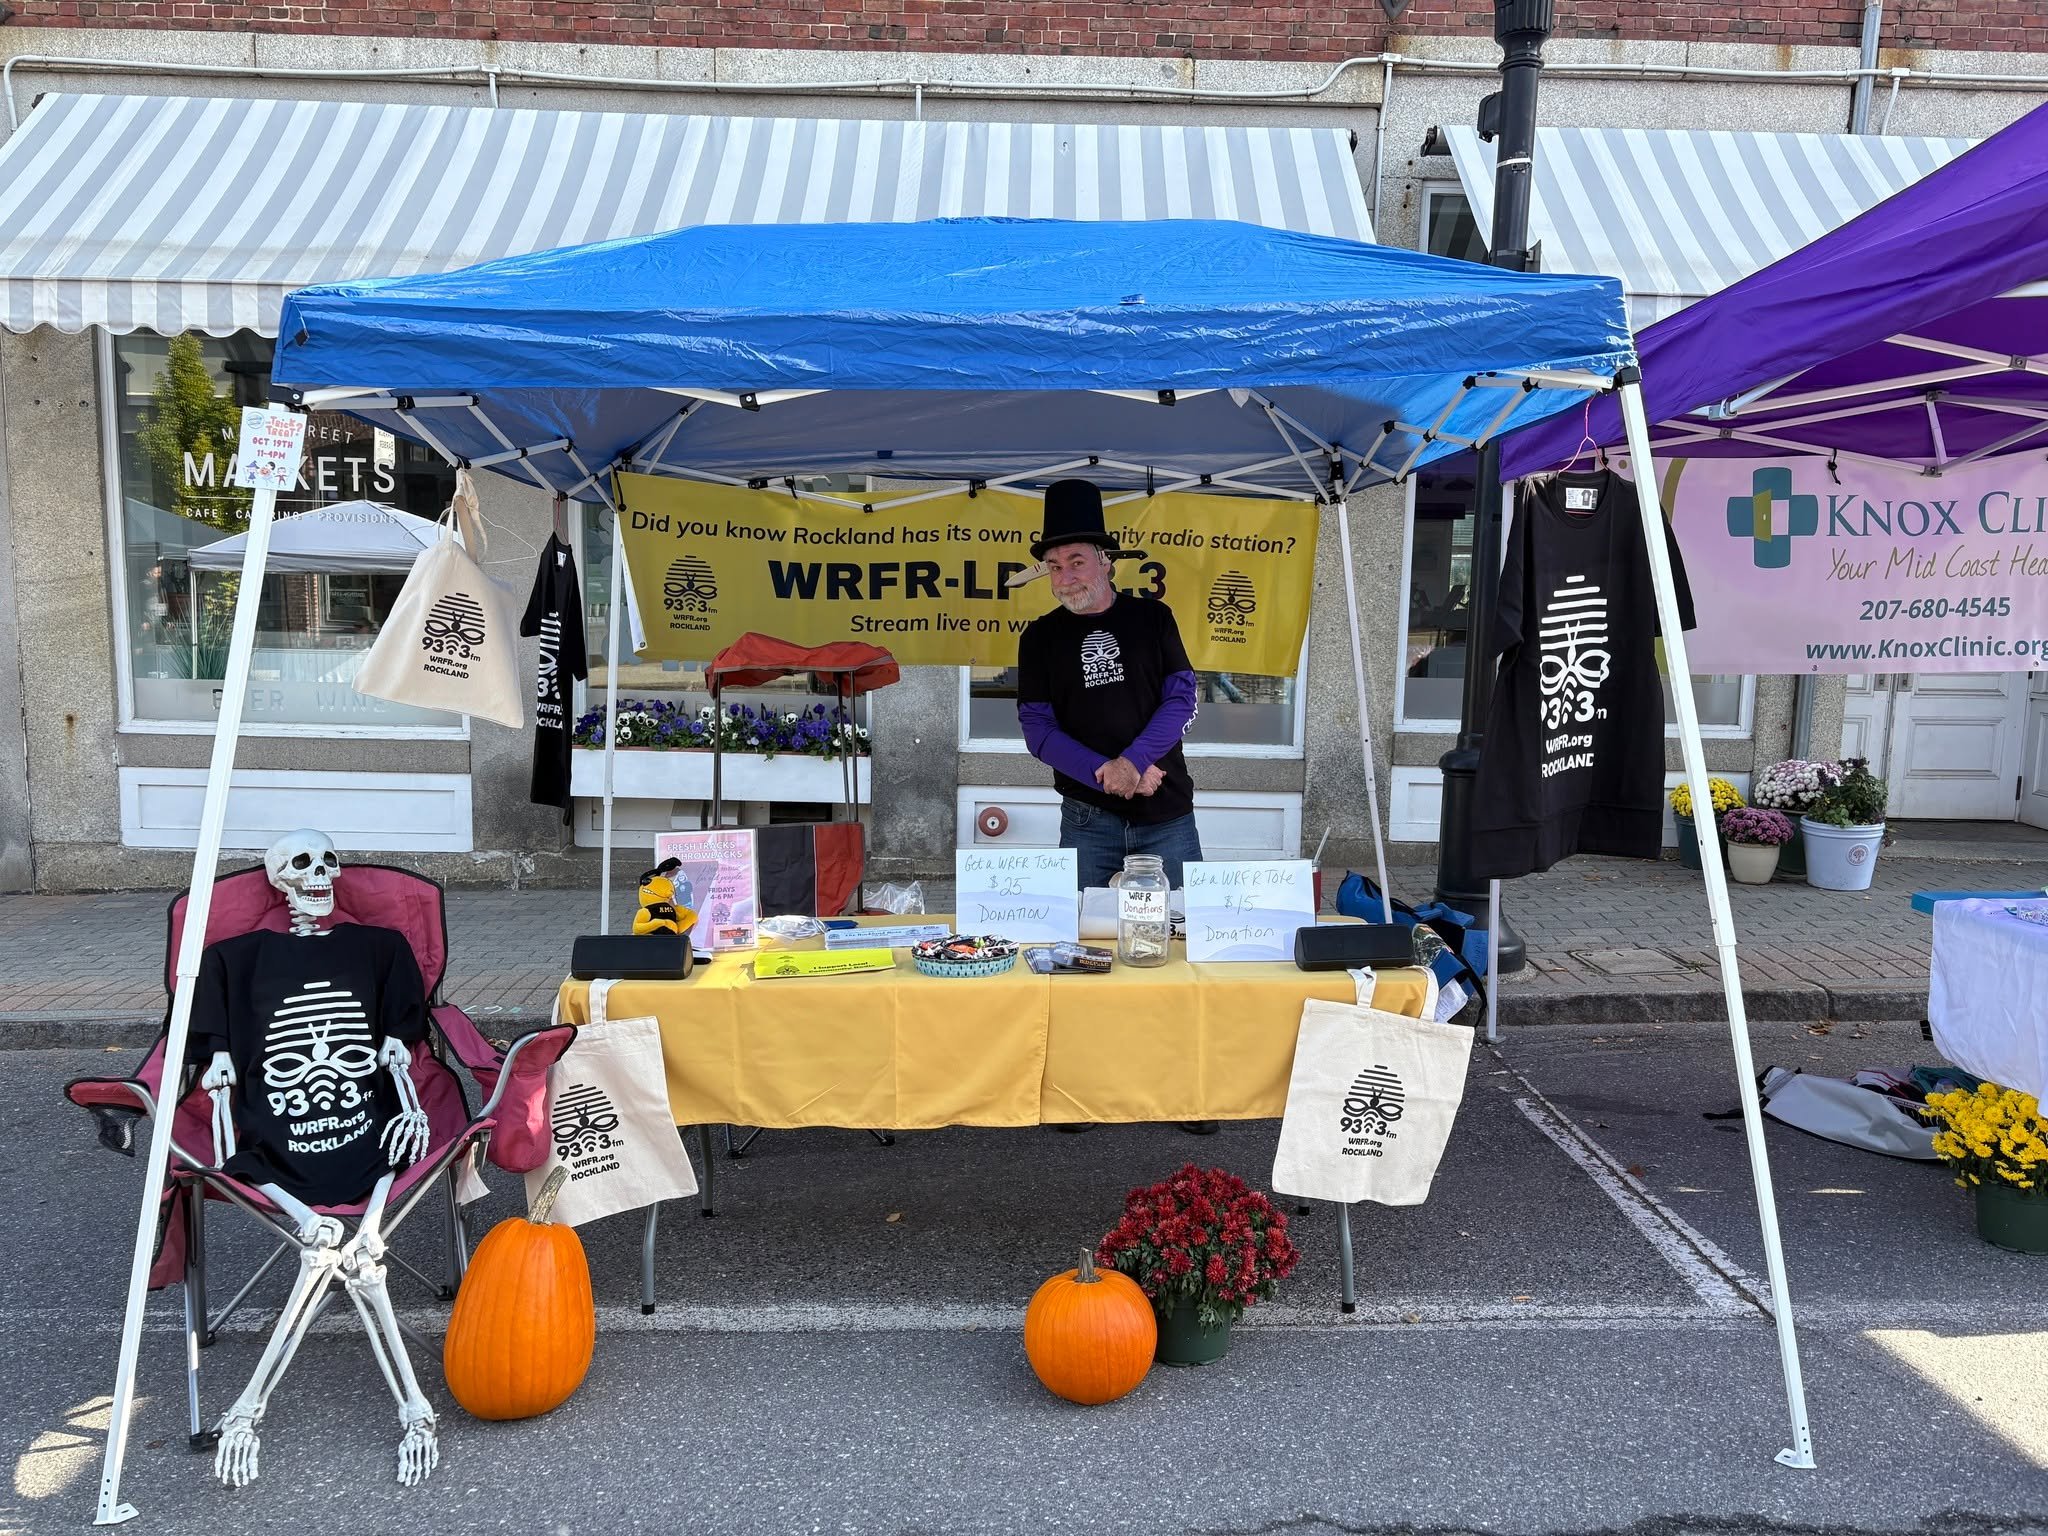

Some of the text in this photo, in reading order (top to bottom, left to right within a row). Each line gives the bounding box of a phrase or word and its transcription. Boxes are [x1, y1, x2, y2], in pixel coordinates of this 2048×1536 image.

[252, 436, 294, 449] OCT 19TH
[257, 449, 286, 460] 11-4PM
[186, 508, 397, 524] CAFE CARING PROVISIONS
[631, 511, 670, 533] Did
[676, 521, 718, 539] you
[725, 520, 787, 542] know
[793, 526, 895, 545] Rockland
[902, 526, 940, 544] has
[946, 524, 972, 542] its
[978, 528, 1022, 543] own
[1150, 529, 1205, 548] radio
[1210, 533, 1296, 554] station?
[1825, 547, 1878, 581] Your
[1884, 546, 1937, 580] Mid
[1945, 544, 2000, 578] Coast
[1859, 596, 2011, 621] 207-680-4545
[673, 614, 708, 623] WRFR.org
[850, 615, 929, 633] Stream
[936, 613, 971, 632] live
[977, 618, 1001, 632] on
[670, 622, 711, 631] ROCKLAND
[1213, 627, 1245, 636] WRFR.org
[1210, 635, 1247, 644] ROCKLAND
[429, 655, 468, 670] WRFR.org
[423, 663, 470, 680] ROCKLAND
[1083, 667, 1124, 682] WRFR-LP
[1085, 674, 1125, 689] ROCKLAND
[212, 688, 285, 712] BER
[1545, 733, 1593, 754] WRFR.org
[667, 840, 736, 852] FRESH TRACKS
[677, 850, 743, 860] THROWBACKS
[964, 854, 986, 872] Get
[998, 855, 1029, 871] WRFR
[1189, 867, 1206, 887] Get
[1221, 870, 1261, 887] WRFR
[708, 886, 736, 894] FRIDAYS
[1128, 891, 1152, 903] WRFR
[977, 903, 1050, 923] DONATION
[1123, 900, 1163, 915] Donations
[1205, 924, 1275, 942] Donation
[289, 1110, 366, 1136] WRFR.org
[287, 1118, 373, 1153] ROCKLAND
[1348, 1137, 1383, 1148] WRFR.org
[1341, 1147, 1383, 1157] ROCKLAND
[572, 1153, 615, 1170] WRFR.org
[570, 1161, 620, 1182] ROCKLAND
